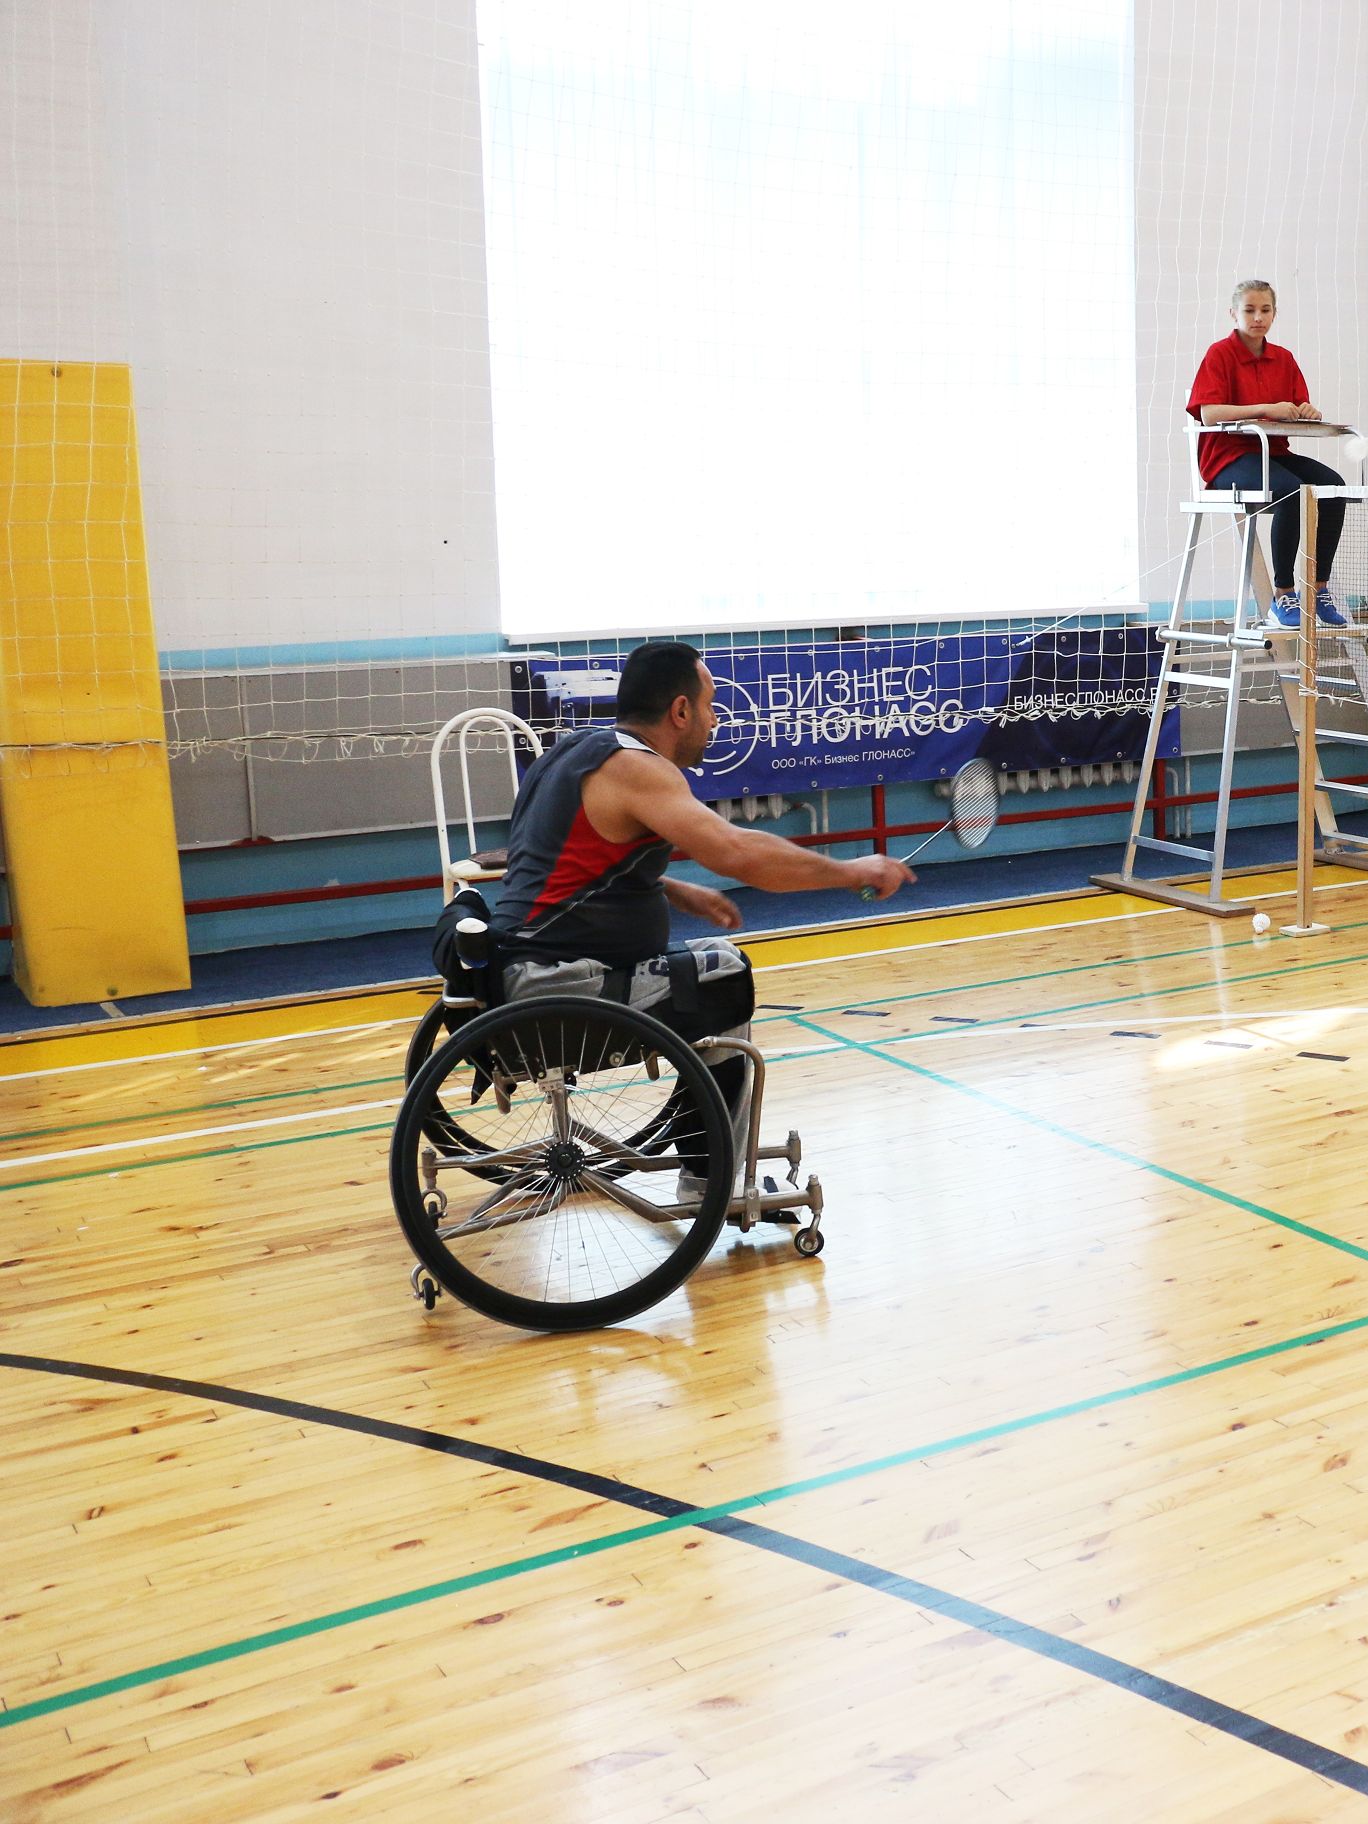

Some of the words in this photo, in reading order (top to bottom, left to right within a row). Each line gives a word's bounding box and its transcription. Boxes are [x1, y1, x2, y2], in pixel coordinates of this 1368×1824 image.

[767, 665, 933, 710] БИЗНЕС
[769, 699, 964, 748] ГЛОНАСС
[771, 757, 797, 770] ООО
[824, 754, 860, 765] Бизнес
